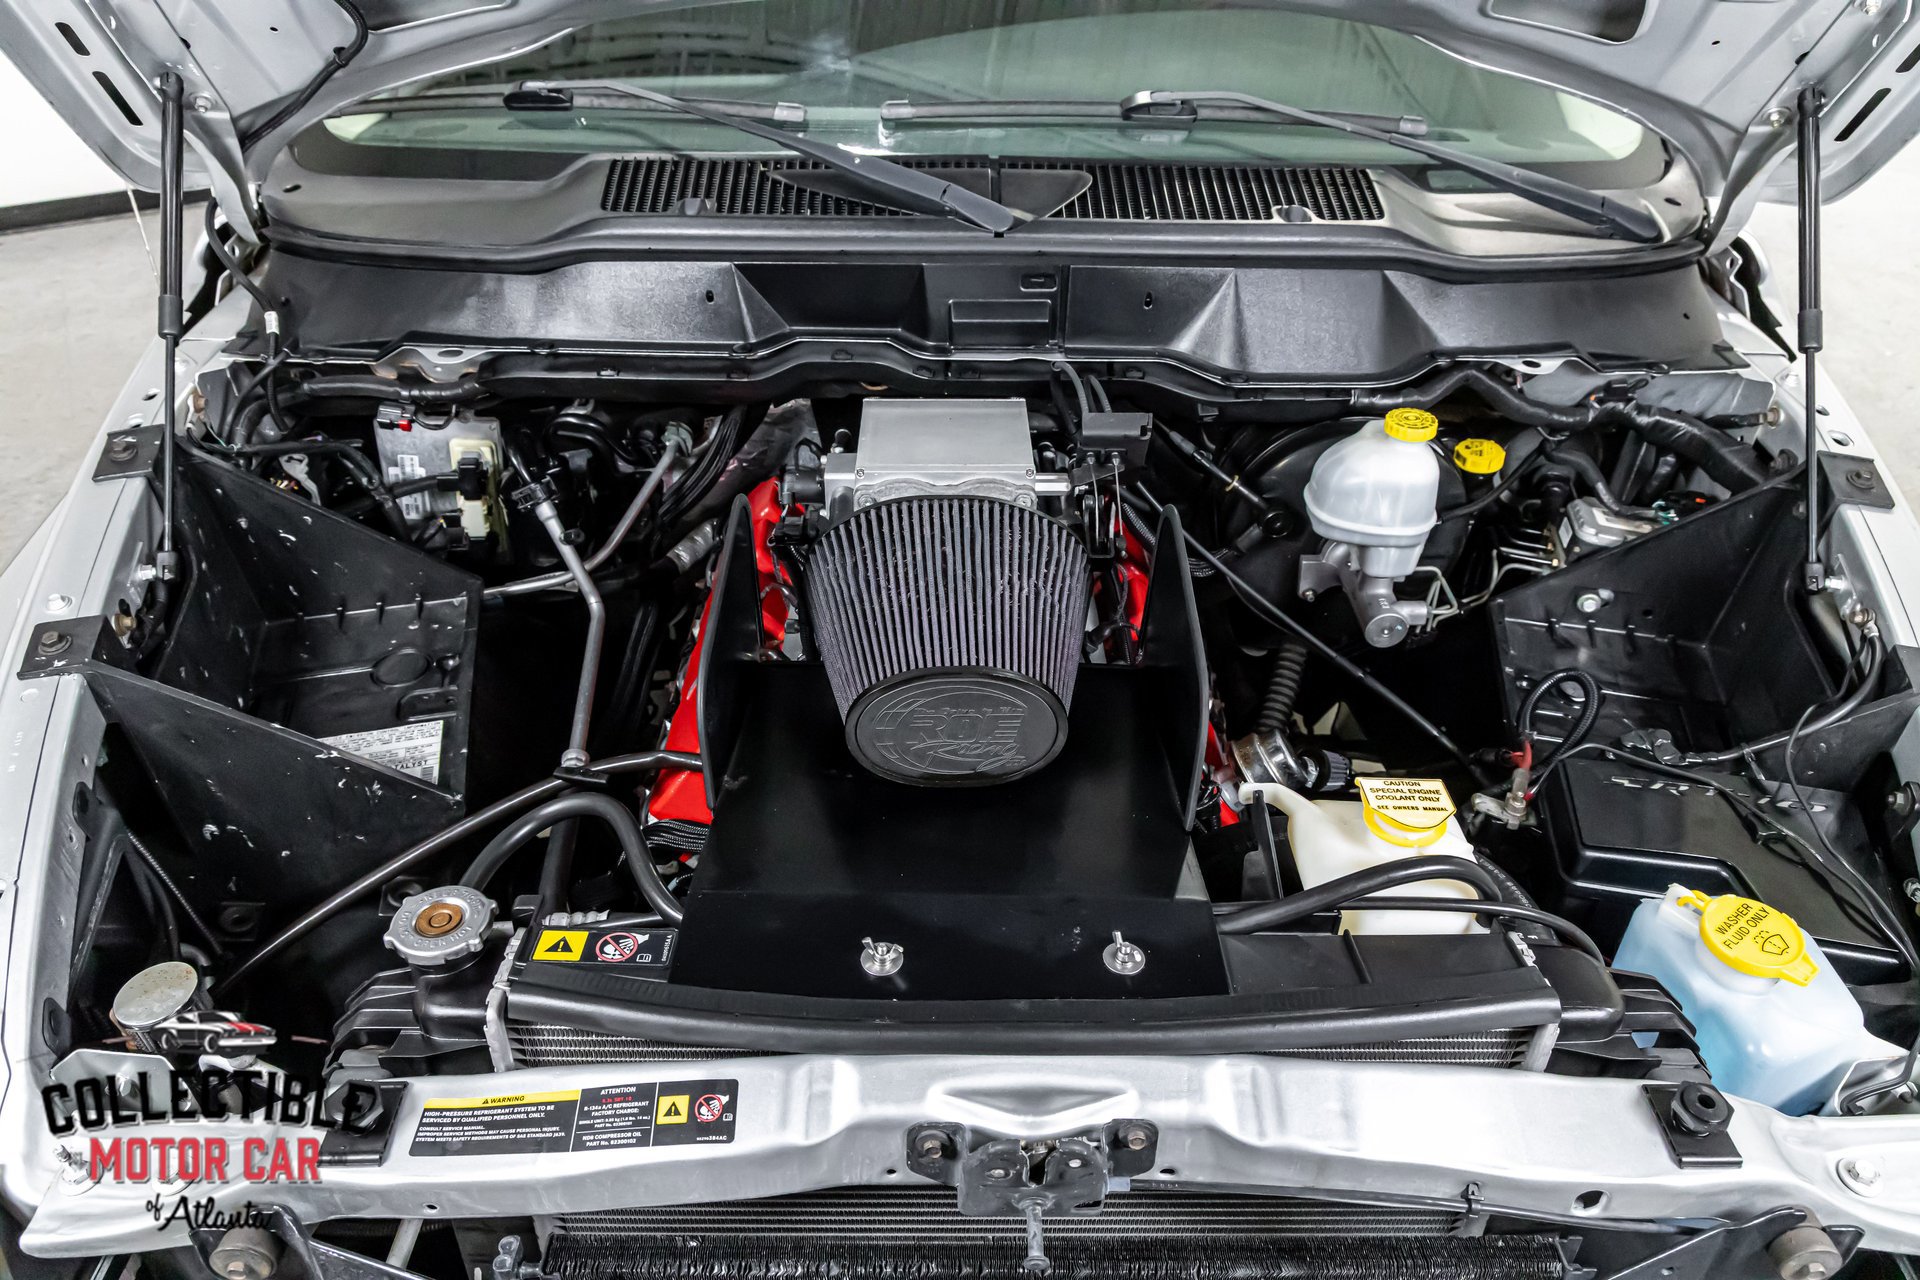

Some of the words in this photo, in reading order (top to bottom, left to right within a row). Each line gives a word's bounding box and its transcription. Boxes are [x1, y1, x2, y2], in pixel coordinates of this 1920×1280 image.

[904, 713, 1026, 744] ROE
[910, 737, 1019, 772] Racing
[1408, 788, 1442, 796] ENGINE
[1715, 902, 1754, 936] WASHER
[1723, 925, 1751, 950] FLUID
[1746, 906, 1770, 928] ONLY
[600, 1086, 636, 1095] ATTENTION
[490, 1095, 525, 1104] WARNING
[613, 1101, 649, 1109] REFRIGERANT
[473, 1107, 514, 1116] REFRIGERANT
[513, 1105, 537, 1113] SYSTEM
[461, 1115, 493, 1123] QUALIFIED
[493, 1113, 528, 1121] PERSONNEL
[594, 1132, 631, 1140] COMPRESSOR
